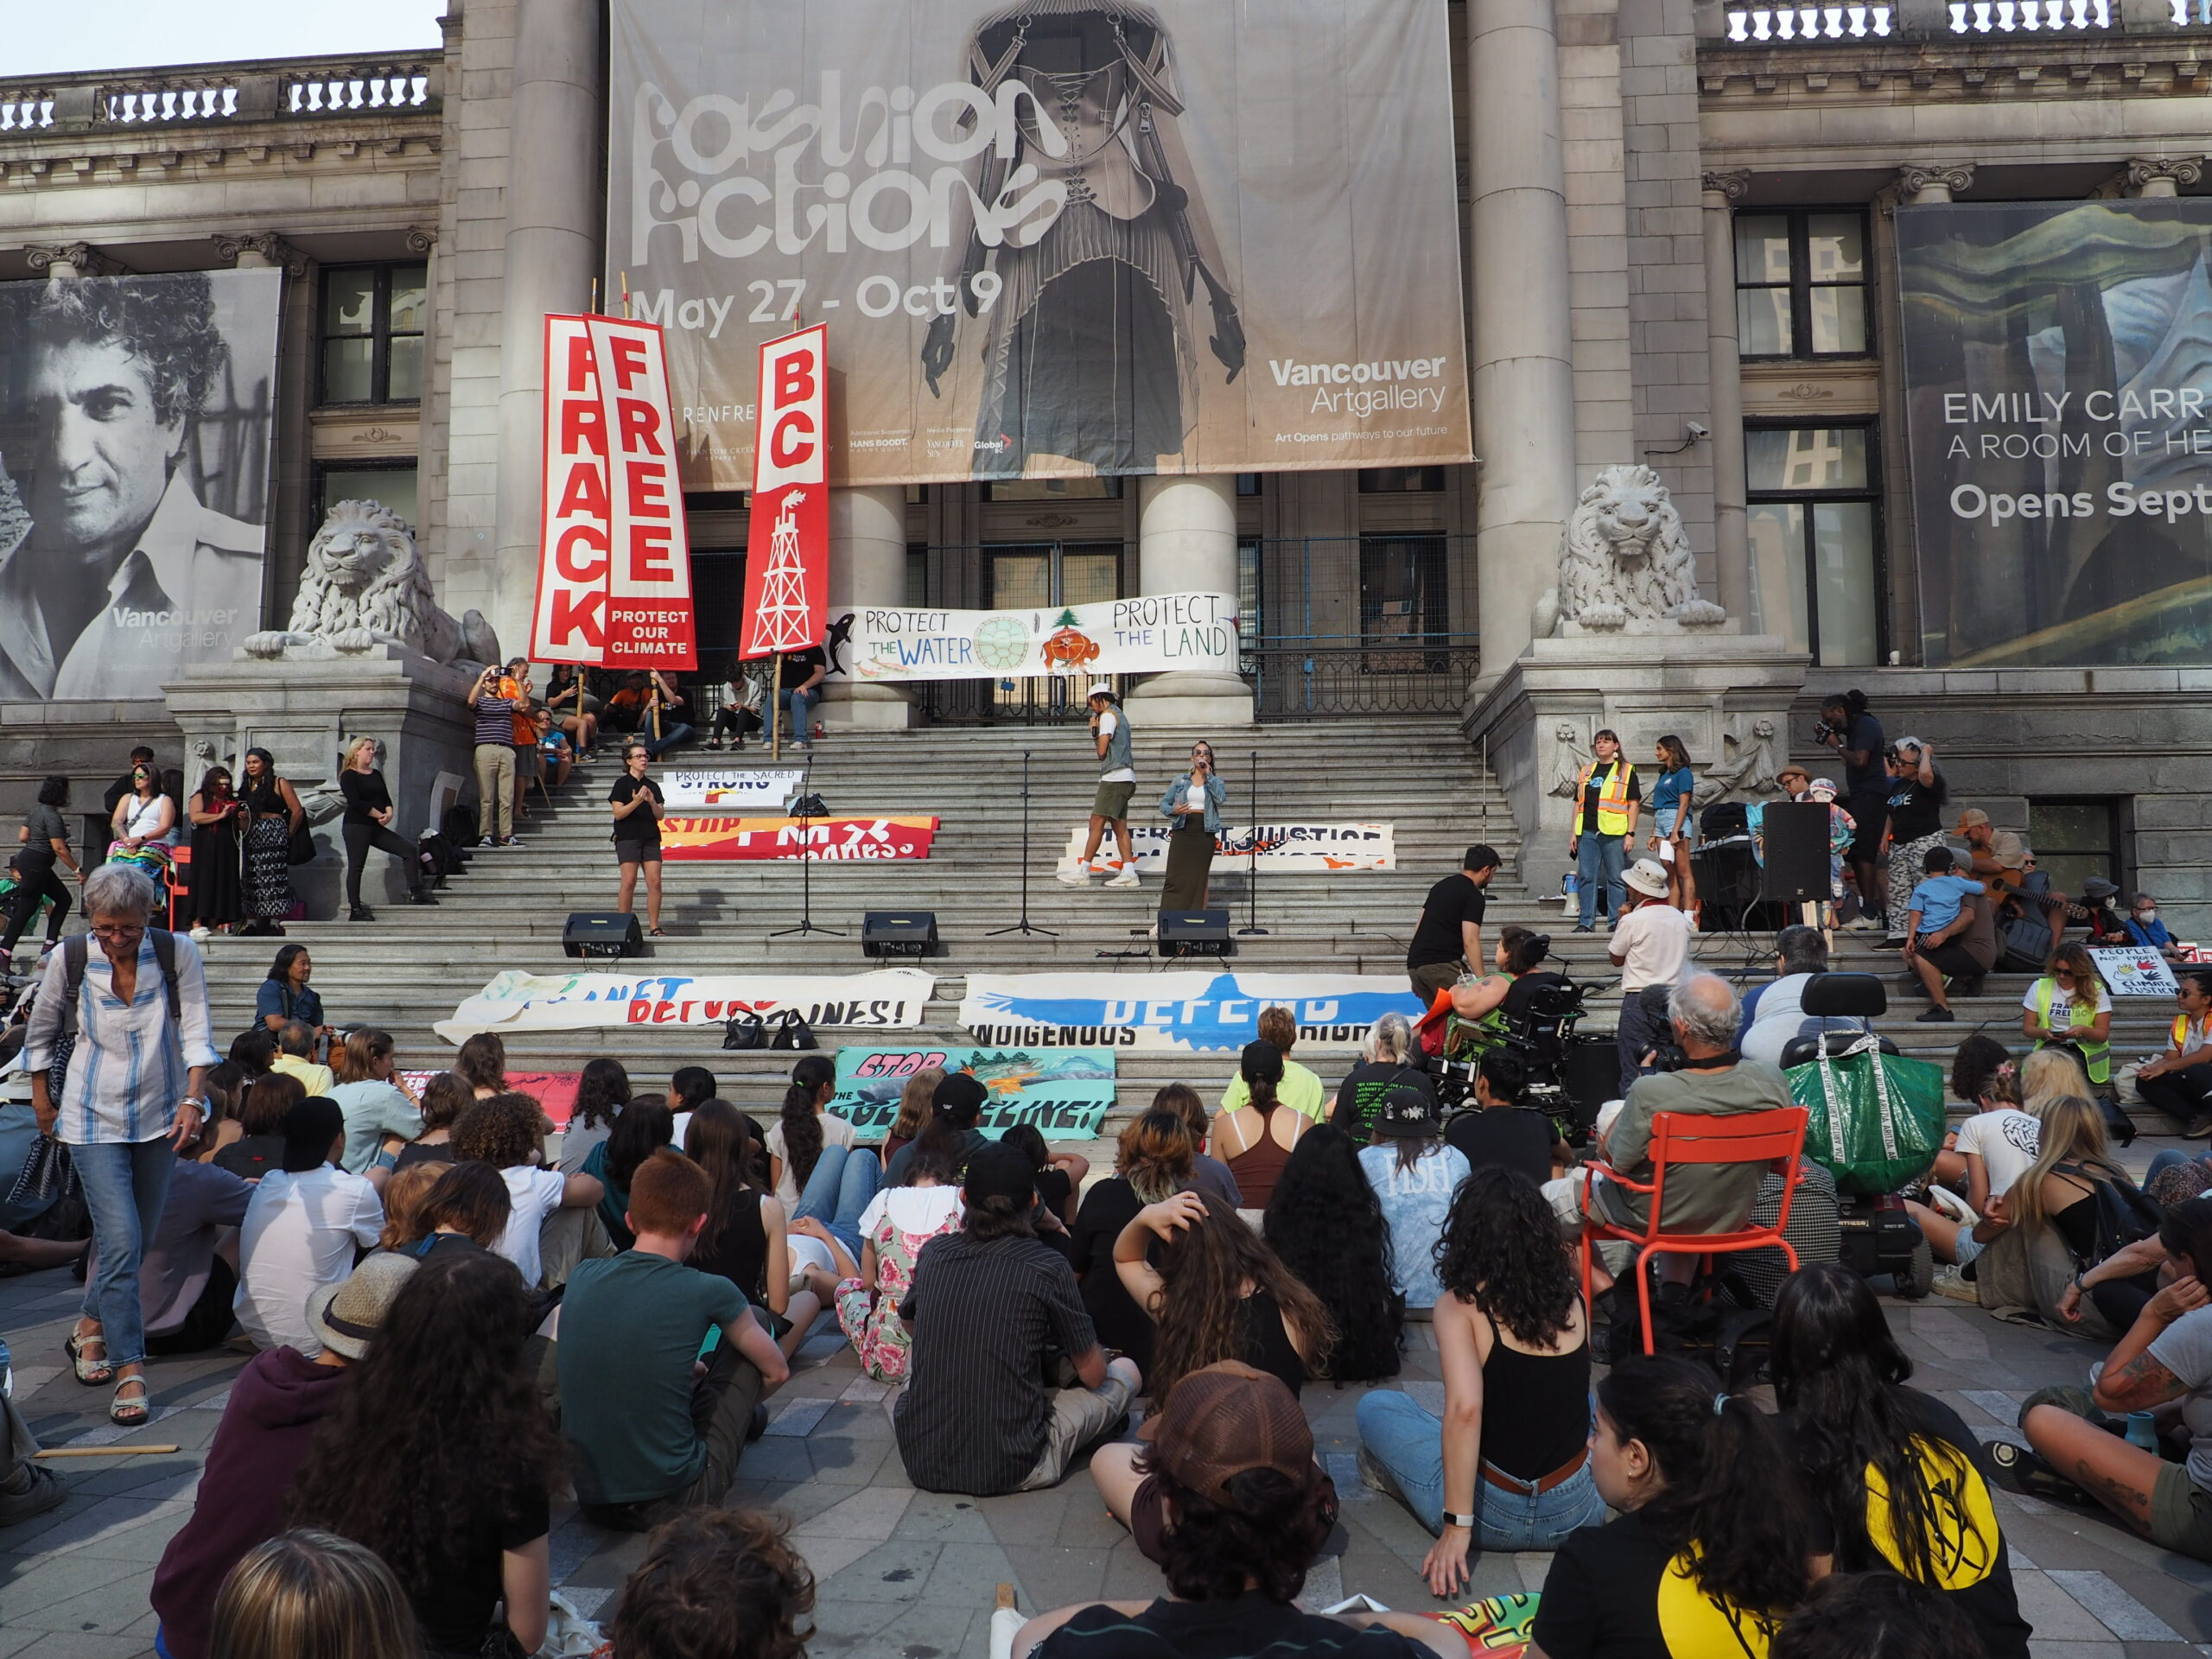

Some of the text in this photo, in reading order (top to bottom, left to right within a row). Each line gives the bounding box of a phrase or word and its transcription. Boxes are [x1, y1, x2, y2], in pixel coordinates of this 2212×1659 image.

[632, 289, 734, 338] May
[747, 279, 806, 323] 27
[856, 275, 955, 317] Oct
[970, 270, 1002, 313] 9
[1269, 356, 1446, 386] Vancouver
[771, 349, 815, 468] BC
[1311, 385, 1446, 417] Artgallery
[1944, 388, 2205, 423] EMILY CARR
[683, 404, 756, 424] RENFRE
[850, 439, 874, 448] HANS
[926, 439, 964, 448] VANCOUVER
[974, 440, 1003, 449] Global
[1275, 434, 1292, 442] Art
[1294, 433, 1329, 443] Opens
[1332, 429, 1381, 443] pathways
[1383, 430, 1394, 439] to
[1415, 425, 1448, 435] future
[1947, 435, 1971, 459] A
[1980, 433, 2091, 459] ROOM
[2103, 431, 2152, 456] OF
[608, 335, 674, 582] FREE
[1950, 481, 2212, 527] Opens Sept
[113, 607, 238, 628] Vancouver
[612, 610, 689, 623] PROTECT
[867, 610, 950, 633] PROTECT
[1114, 595, 1219, 628] PROTECT
[138, 628, 236, 653] Artgallery
[632, 626, 669, 639] OUR
[1114, 626, 1227, 658] THE LAND
[612, 642, 687, 654] CLIMATE
[868, 637, 972, 666] THE WATER
[676, 771, 727, 782] PROTECT
[753, 770, 795, 781] SACRED
[2099, 947, 2152, 956] PEOPLE
[846, 1052, 946, 1079] STOP
[1821, 1070, 1833, 1093] ARITZIA
[1875, 1073, 1886, 1098] ARITZIA
[1827, 1095, 1839, 1119] ARITZIA
[1879, 1099, 1890, 1123] ARITZIA
[1831, 1121, 1842, 1145] ARITZIA
[1883, 1125, 1894, 1149] ARITZIA
